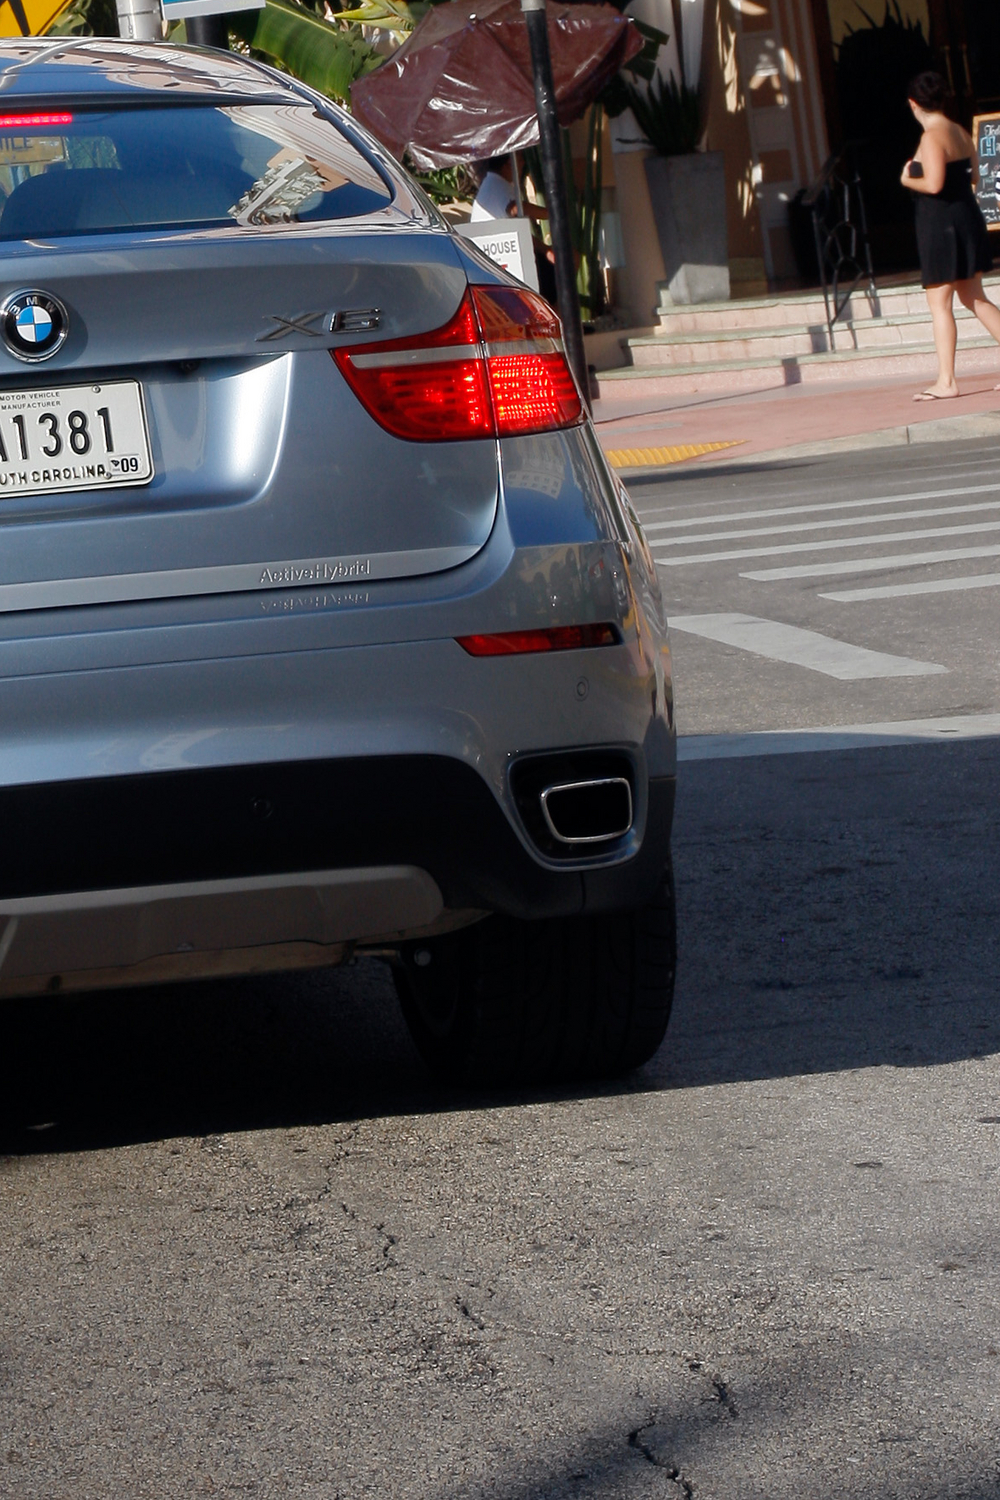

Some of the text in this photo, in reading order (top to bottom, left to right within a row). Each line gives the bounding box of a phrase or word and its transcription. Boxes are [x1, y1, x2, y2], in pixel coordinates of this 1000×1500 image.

[482, 240, 518, 256] HOUSE
[9, 296, 56, 316] BMW
[253, 307, 381, 342] X6
[29, 391, 60, 399] VEHICLE
[1, 400, 61, 410] MANUFACTURER
[32, 463, 106, 483] CAROLINA
[121, 457, 139, 473] 09
[259, 559, 371, 584] ActiveHybrid
